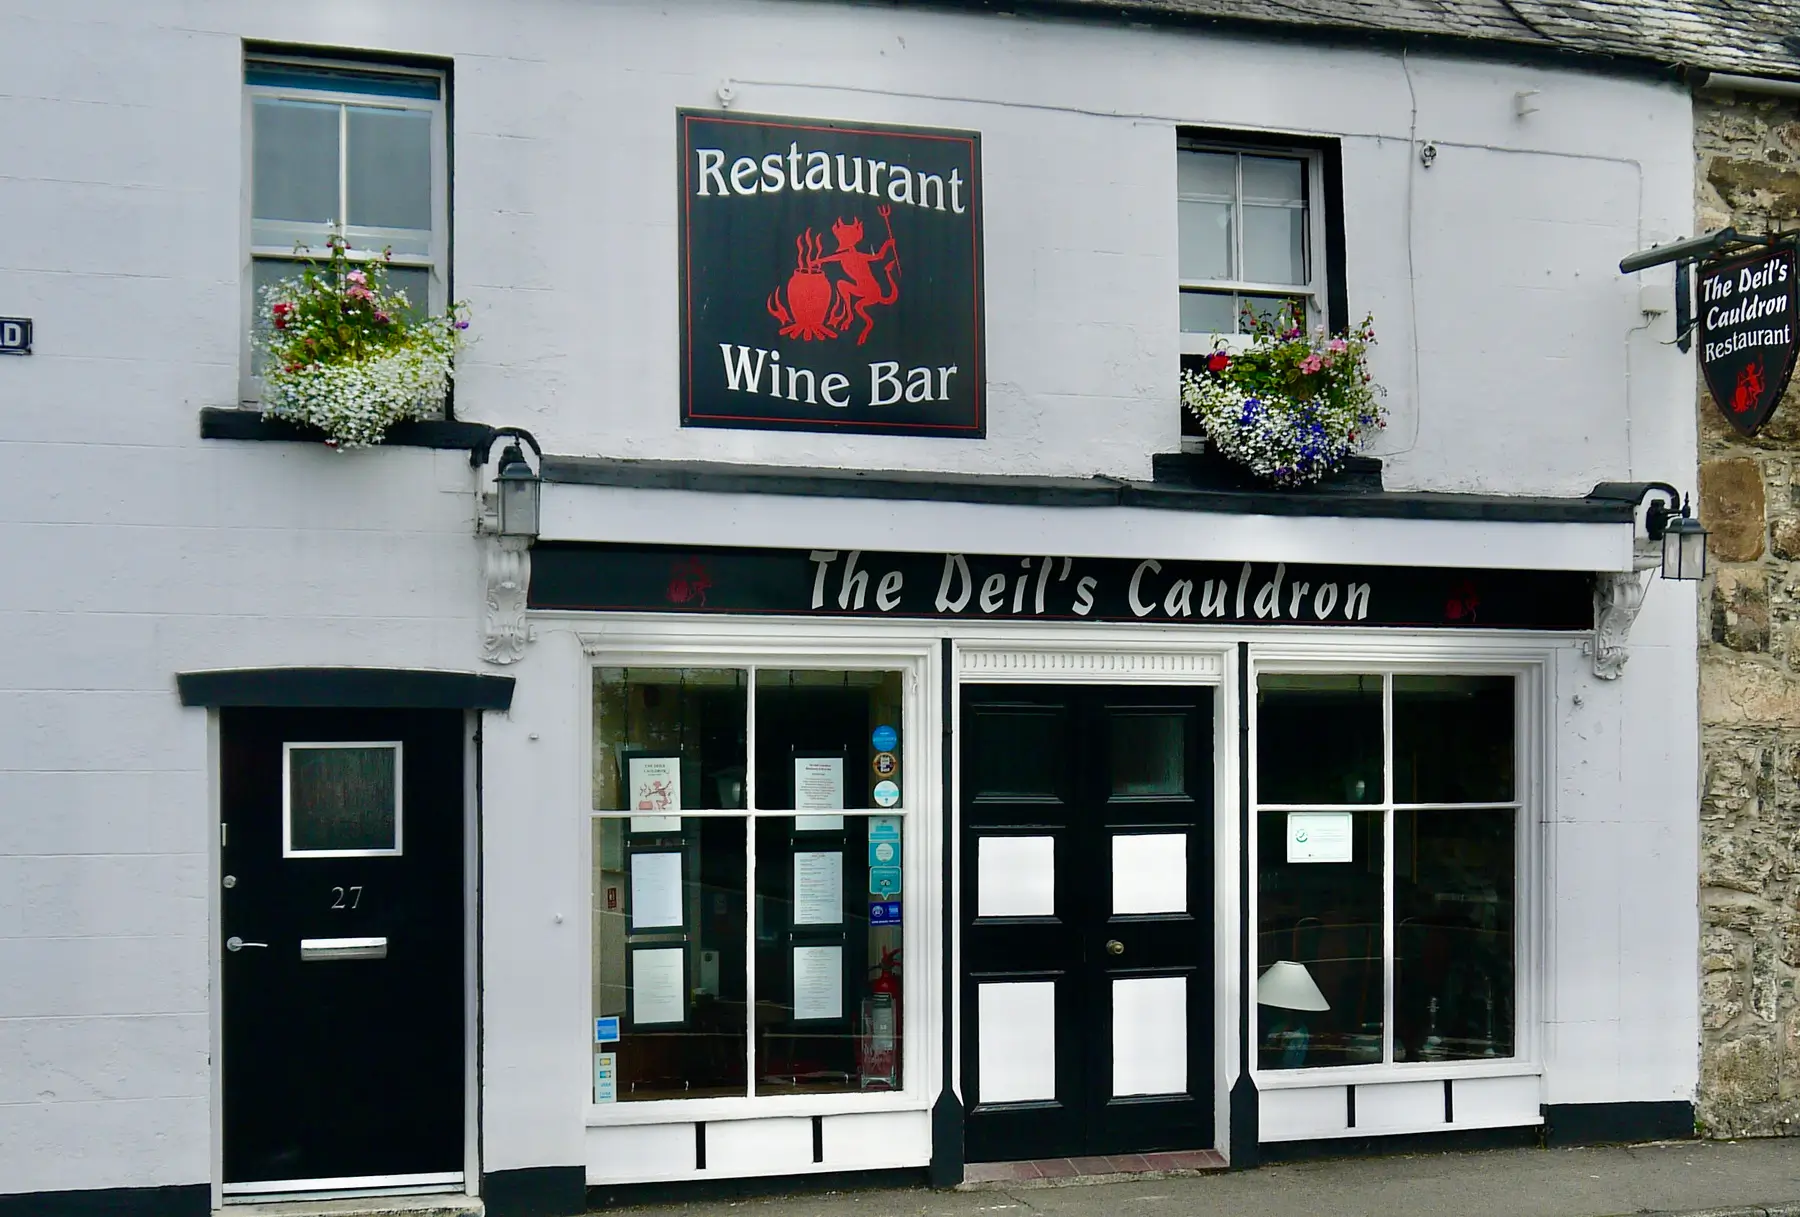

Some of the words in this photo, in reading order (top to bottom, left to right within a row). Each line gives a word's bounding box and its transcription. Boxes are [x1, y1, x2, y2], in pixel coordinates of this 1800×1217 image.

[696, 141, 965, 214] Restaurant
[1703, 274, 1732, 302] The
[1738, 258, 1788, 294] Deil's
[1706, 294, 1788, 331] Cauldron
[0, 322, 21, 347] D
[1705, 324, 1791, 363] Restaurant
[719, 343, 851, 408] Wine
[868, 360, 957, 406] Bar
[809, 550, 903, 611] The
[935, 553, 1098, 616] Deil's
[1128, 558, 1371, 621] Cauldron
[331, 886, 363, 909] 27
